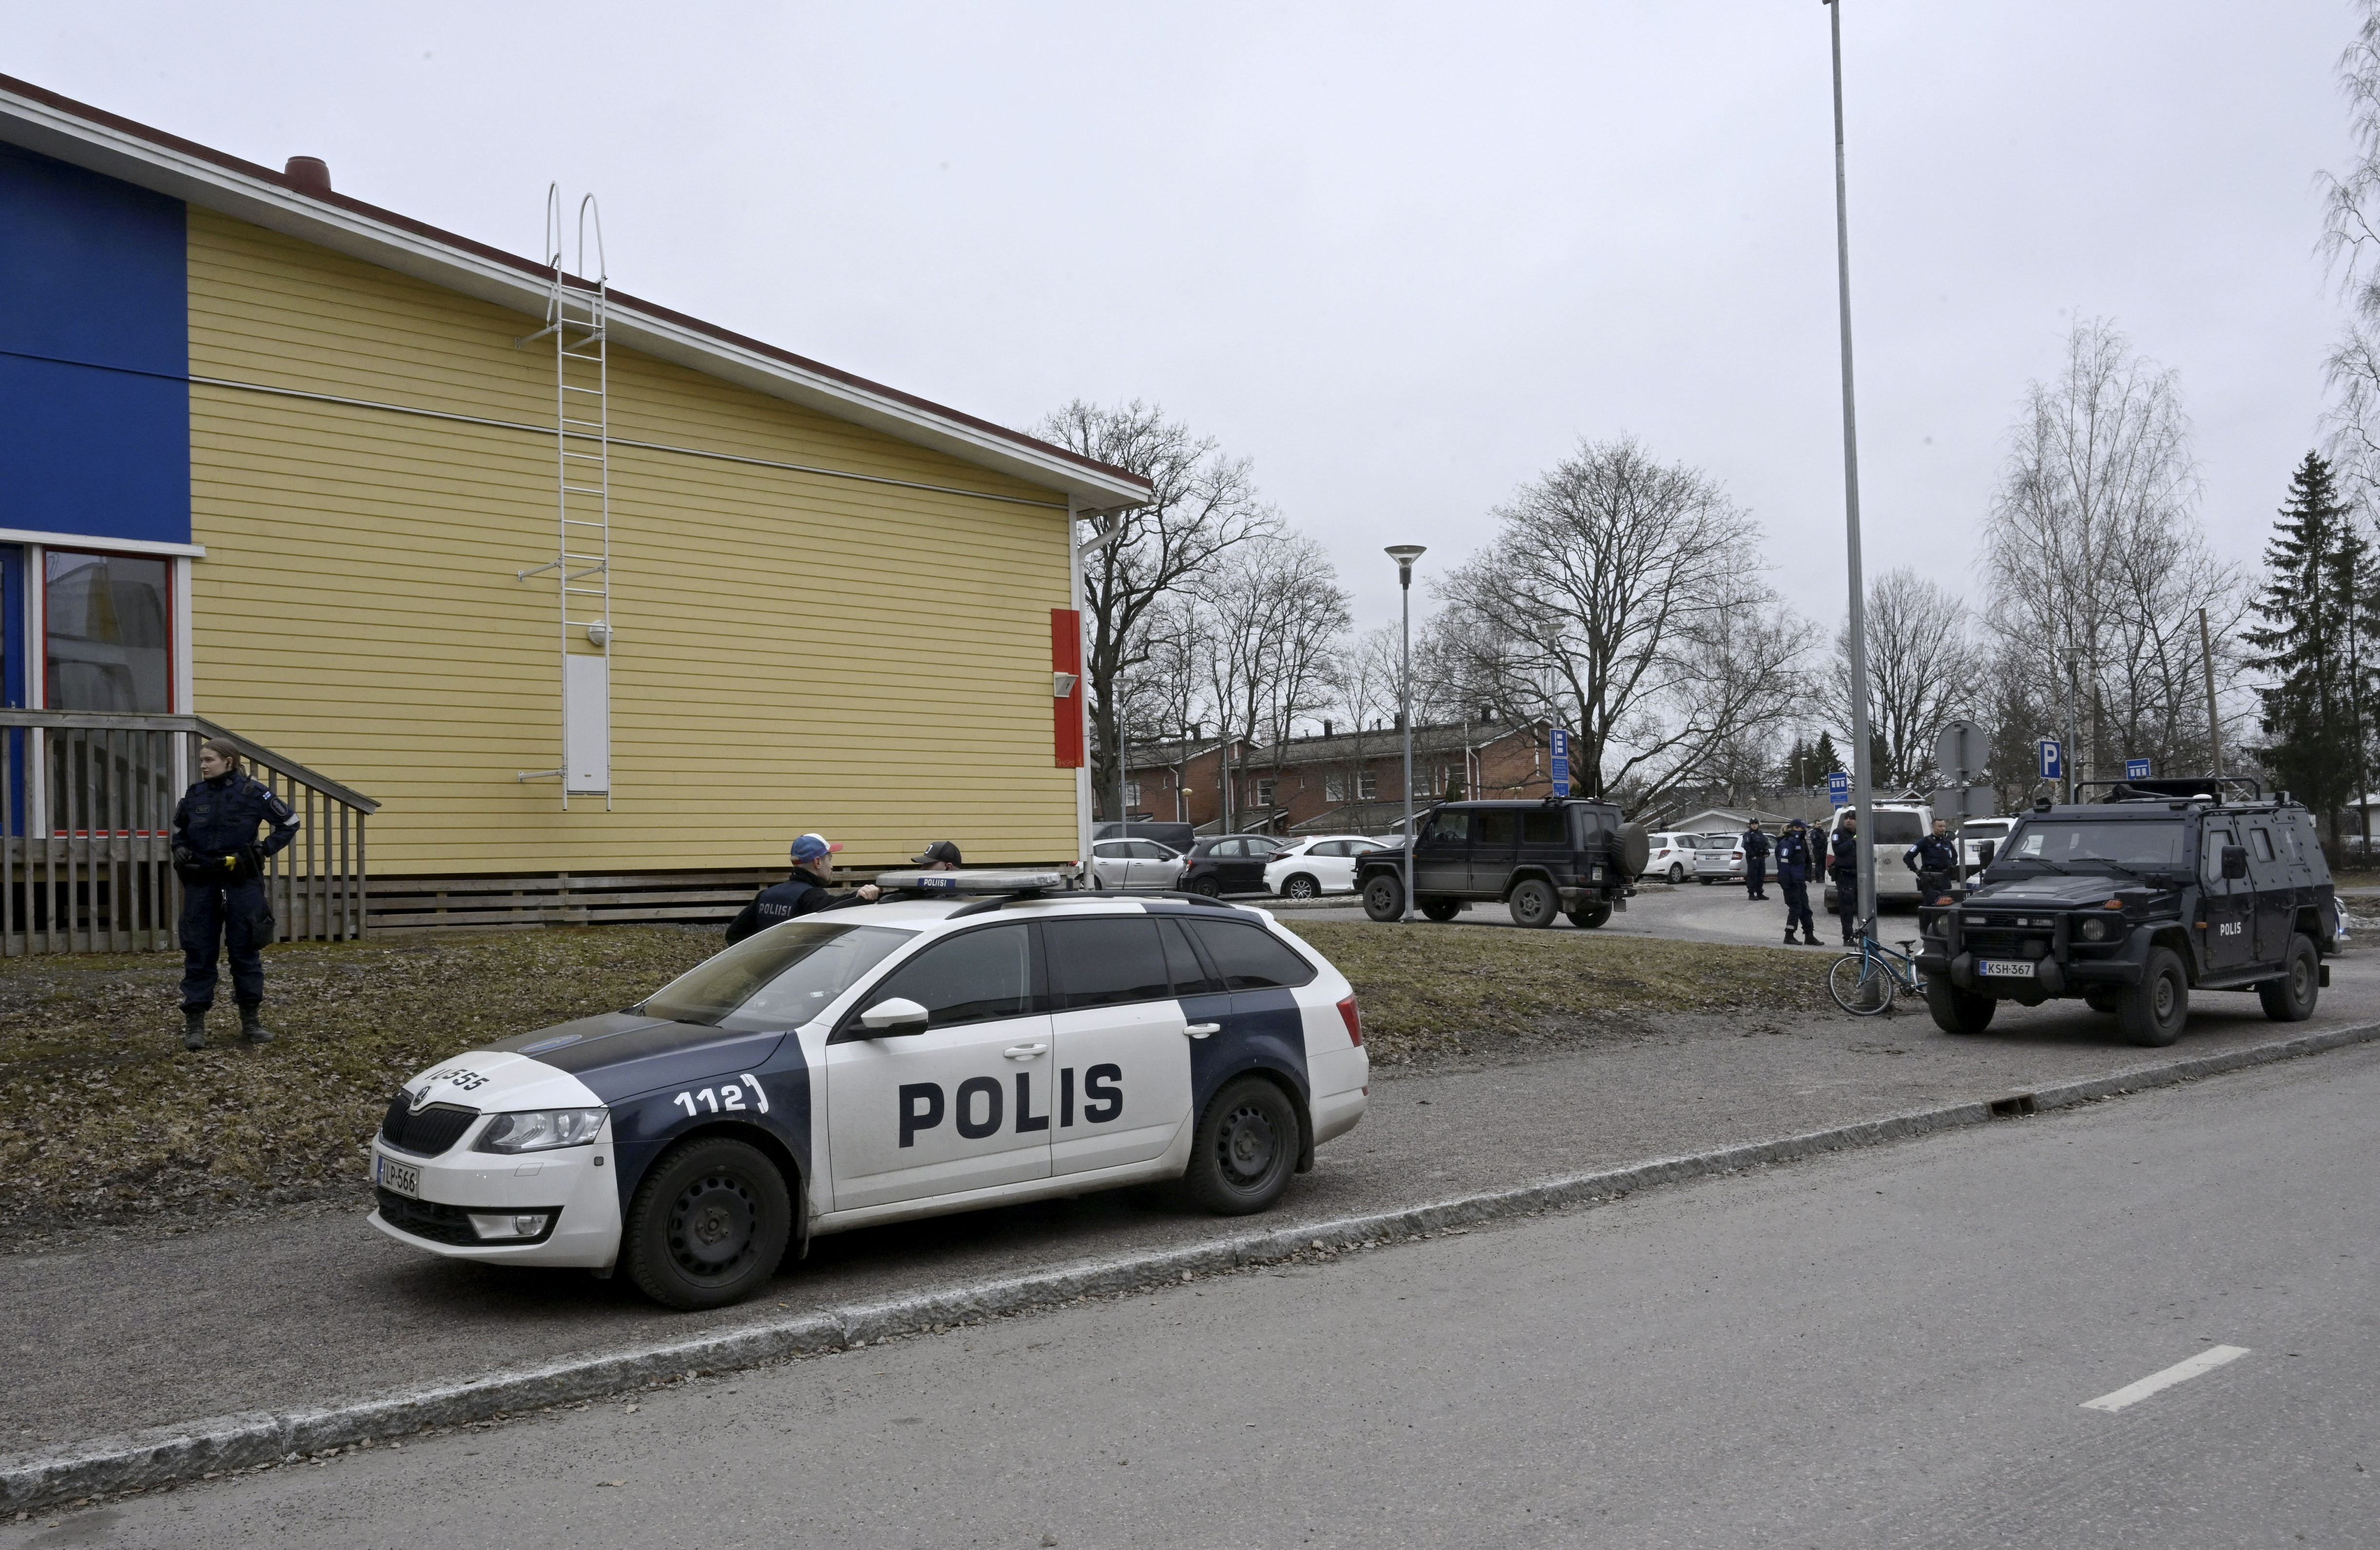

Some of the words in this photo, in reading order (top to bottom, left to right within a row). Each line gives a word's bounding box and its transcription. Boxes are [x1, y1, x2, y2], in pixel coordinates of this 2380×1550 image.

[2044, 744, 2057, 775] P
[759, 903, 791, 916] POLIISI
[2220, 922, 2241, 936] POLIS
[674, 1085, 746, 1117] 112
[899, 1063, 1123, 1148] POLIS
